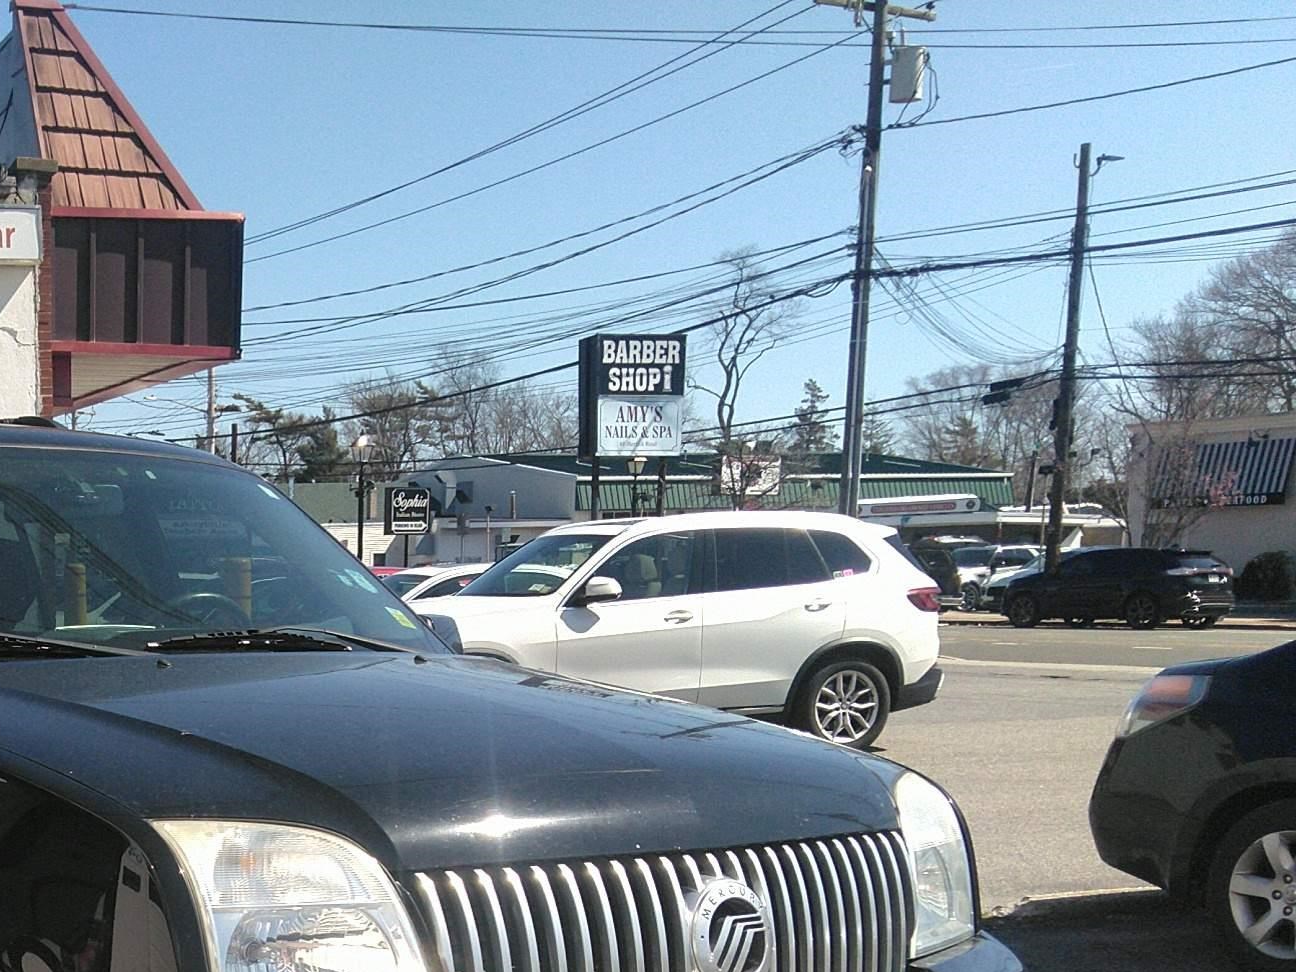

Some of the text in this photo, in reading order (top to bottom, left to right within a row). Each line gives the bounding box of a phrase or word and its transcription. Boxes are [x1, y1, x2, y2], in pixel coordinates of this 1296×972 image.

[602, 340, 681, 364] BARBER
[608, 367, 661, 391] SHOP
[615, 405, 664, 423] AMY'S
[605, 425, 673, 438] NAILS & SPA
